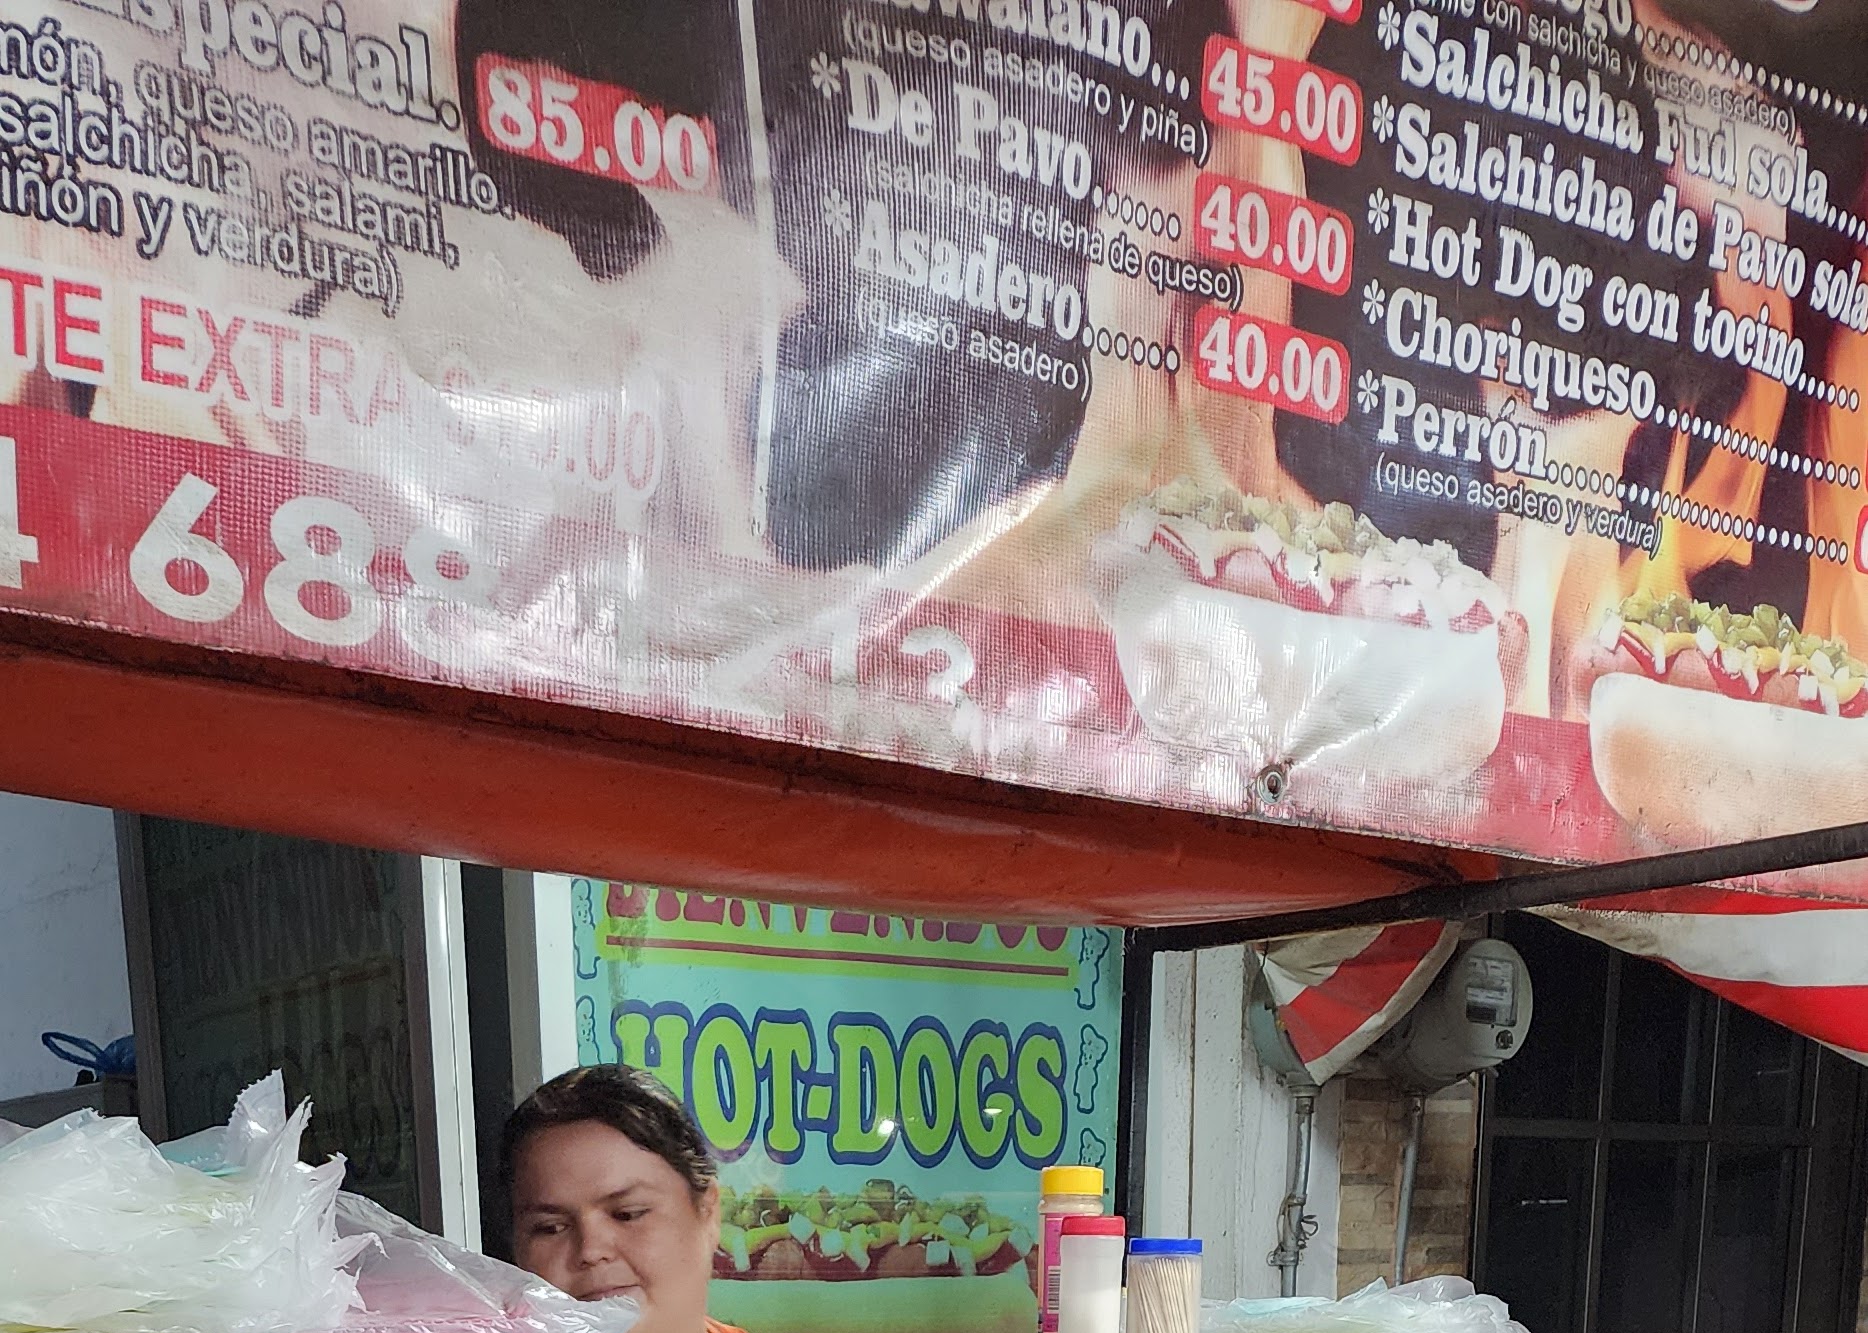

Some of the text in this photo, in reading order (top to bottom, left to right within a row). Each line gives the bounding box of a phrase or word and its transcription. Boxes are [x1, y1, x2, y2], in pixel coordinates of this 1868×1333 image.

[134, 58, 302, 152] queso
[842, 57, 933, 147] De
[983, 46, 1112, 117] asadero
[1118, 98, 1135, 134] y
[1141, 103, 1210, 169] piña)
[1208, 47, 1357, 154] 45.00
[1401, 9, 1644, 154] Salchicha
[1626, 52, 1638, 90] y
[487, 65, 712, 193] 85.00
[133, 190, 173, 261] y
[181, 198, 403, 320] verdura)
[281, 165, 460, 271] salami,
[1200, 184, 1348, 285] 40.00
[1395, 102, 1635, 242] Salchicha
[1648, 184, 1699, 261] de
[1708, 201, 1807, 299] Pavo
[1021, 203, 1104, 267] rellena
[1108, 229, 1142, 278] de
[1146, 252, 1244, 312] queso)
[1388, 193, 1482, 287] Hot
[1494, 224, 1594, 332] Dog
[1602, 275, 1680, 343] con
[138, 295, 408, 428] EXTRA
[968, 324, 1092, 402] asadero)
[1199, 316, 1343, 411] 40.00
[1375, 450, 1664, 561] (queso asadero y verdura)
